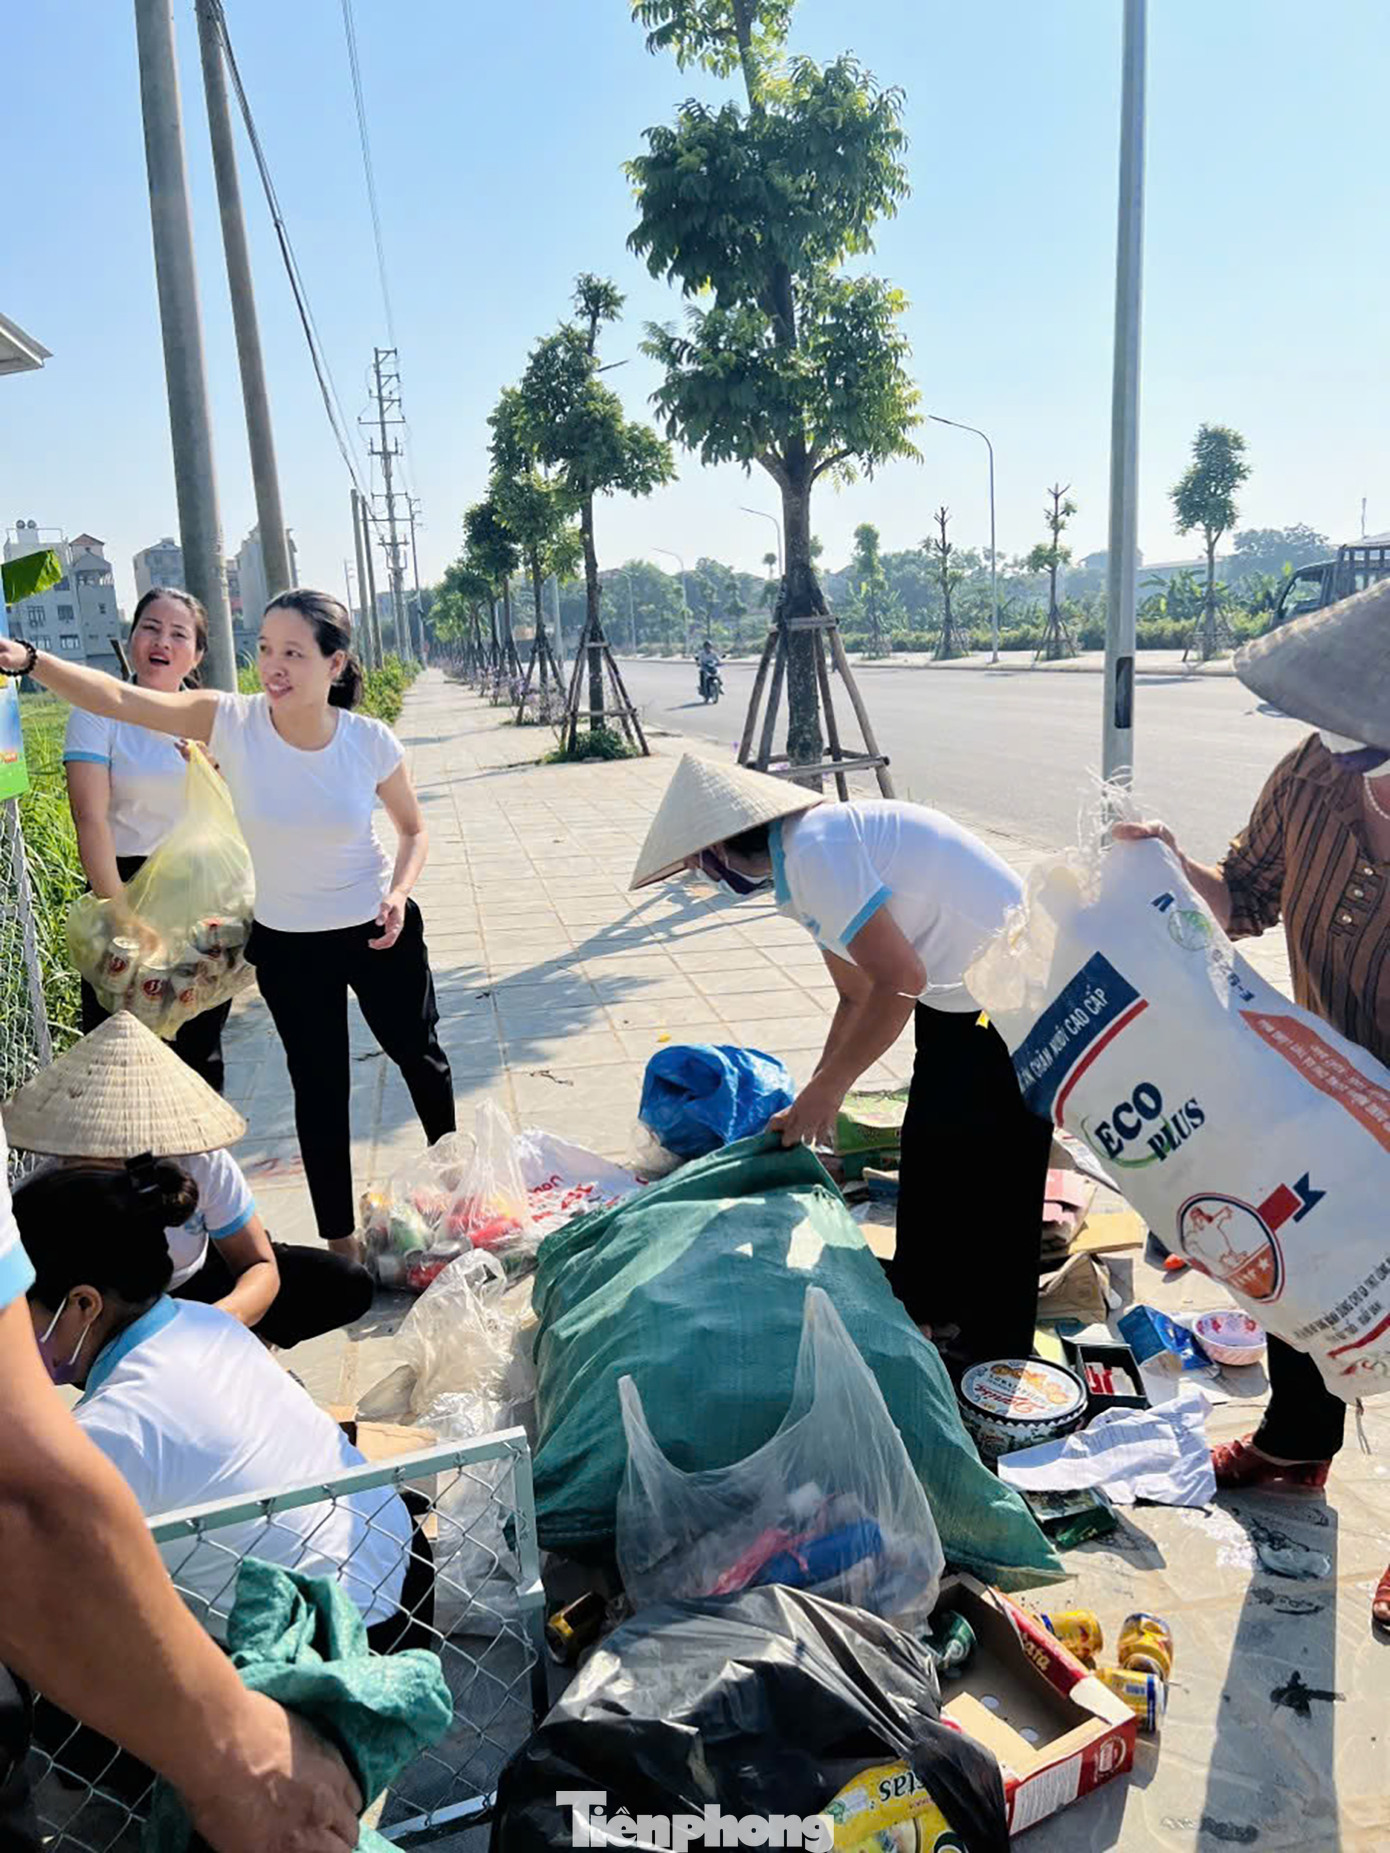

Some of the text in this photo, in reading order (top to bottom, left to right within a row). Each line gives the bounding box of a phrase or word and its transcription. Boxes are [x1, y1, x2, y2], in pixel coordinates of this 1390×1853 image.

[1064, 1007, 1090, 1036] CAO
[1083, 984, 1110, 1016] CẤP
[1094, 1082, 1162, 1159] ECO
[1147, 1097, 1205, 1162] PLUS
